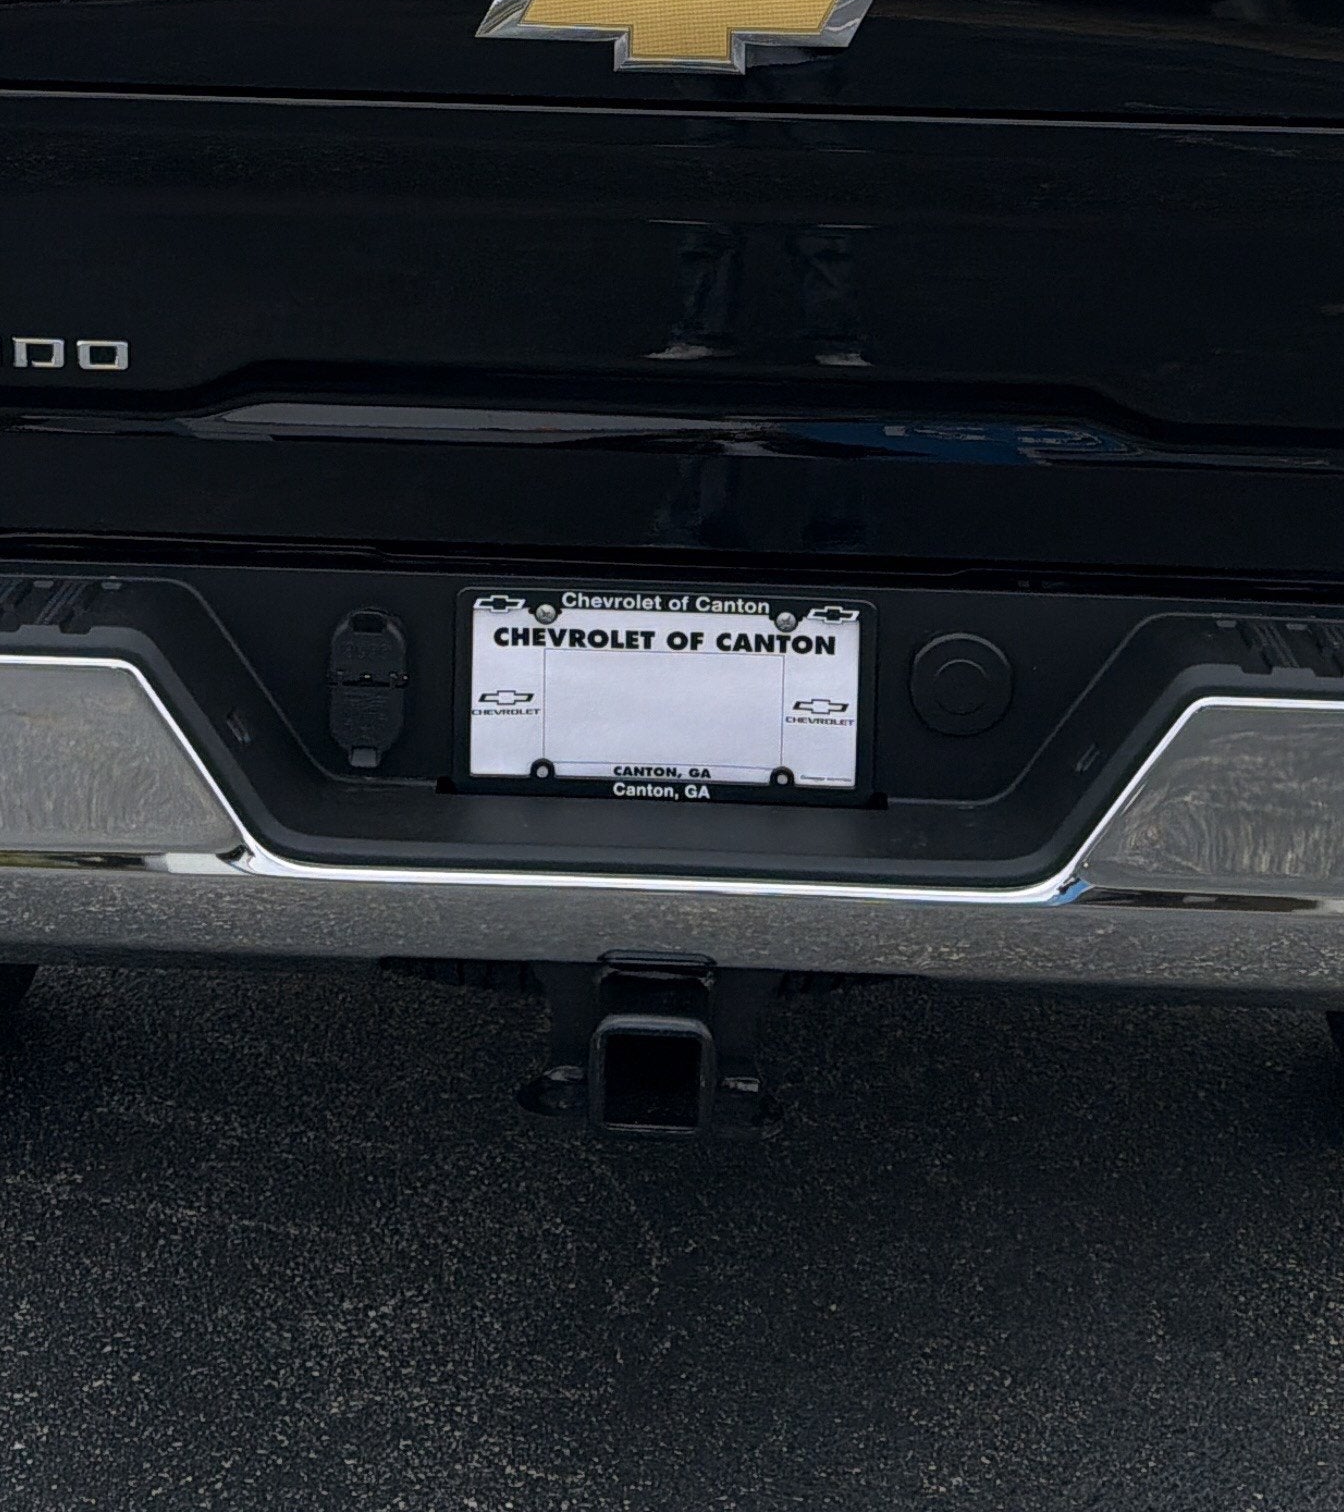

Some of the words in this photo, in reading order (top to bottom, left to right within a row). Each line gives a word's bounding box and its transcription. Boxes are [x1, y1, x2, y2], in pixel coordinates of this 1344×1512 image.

[561, 591, 662, 611] Chevrolet
[668, 596, 690, 611] of
[695, 596, 770, 614] Canton
[493, 627, 656, 650] CHEVROLET
[666, 631, 704, 651] OF
[716, 632, 836, 655] CANTON
[471, 708, 541, 716] CHEVROLET
[785, 716, 855, 726] CHEVROLET
[613, 766, 682, 778] CANTON,
[689, 768, 711, 779] GA
[613, 782, 679, 800] Canton,
[684, 784, 711, 799] GA
